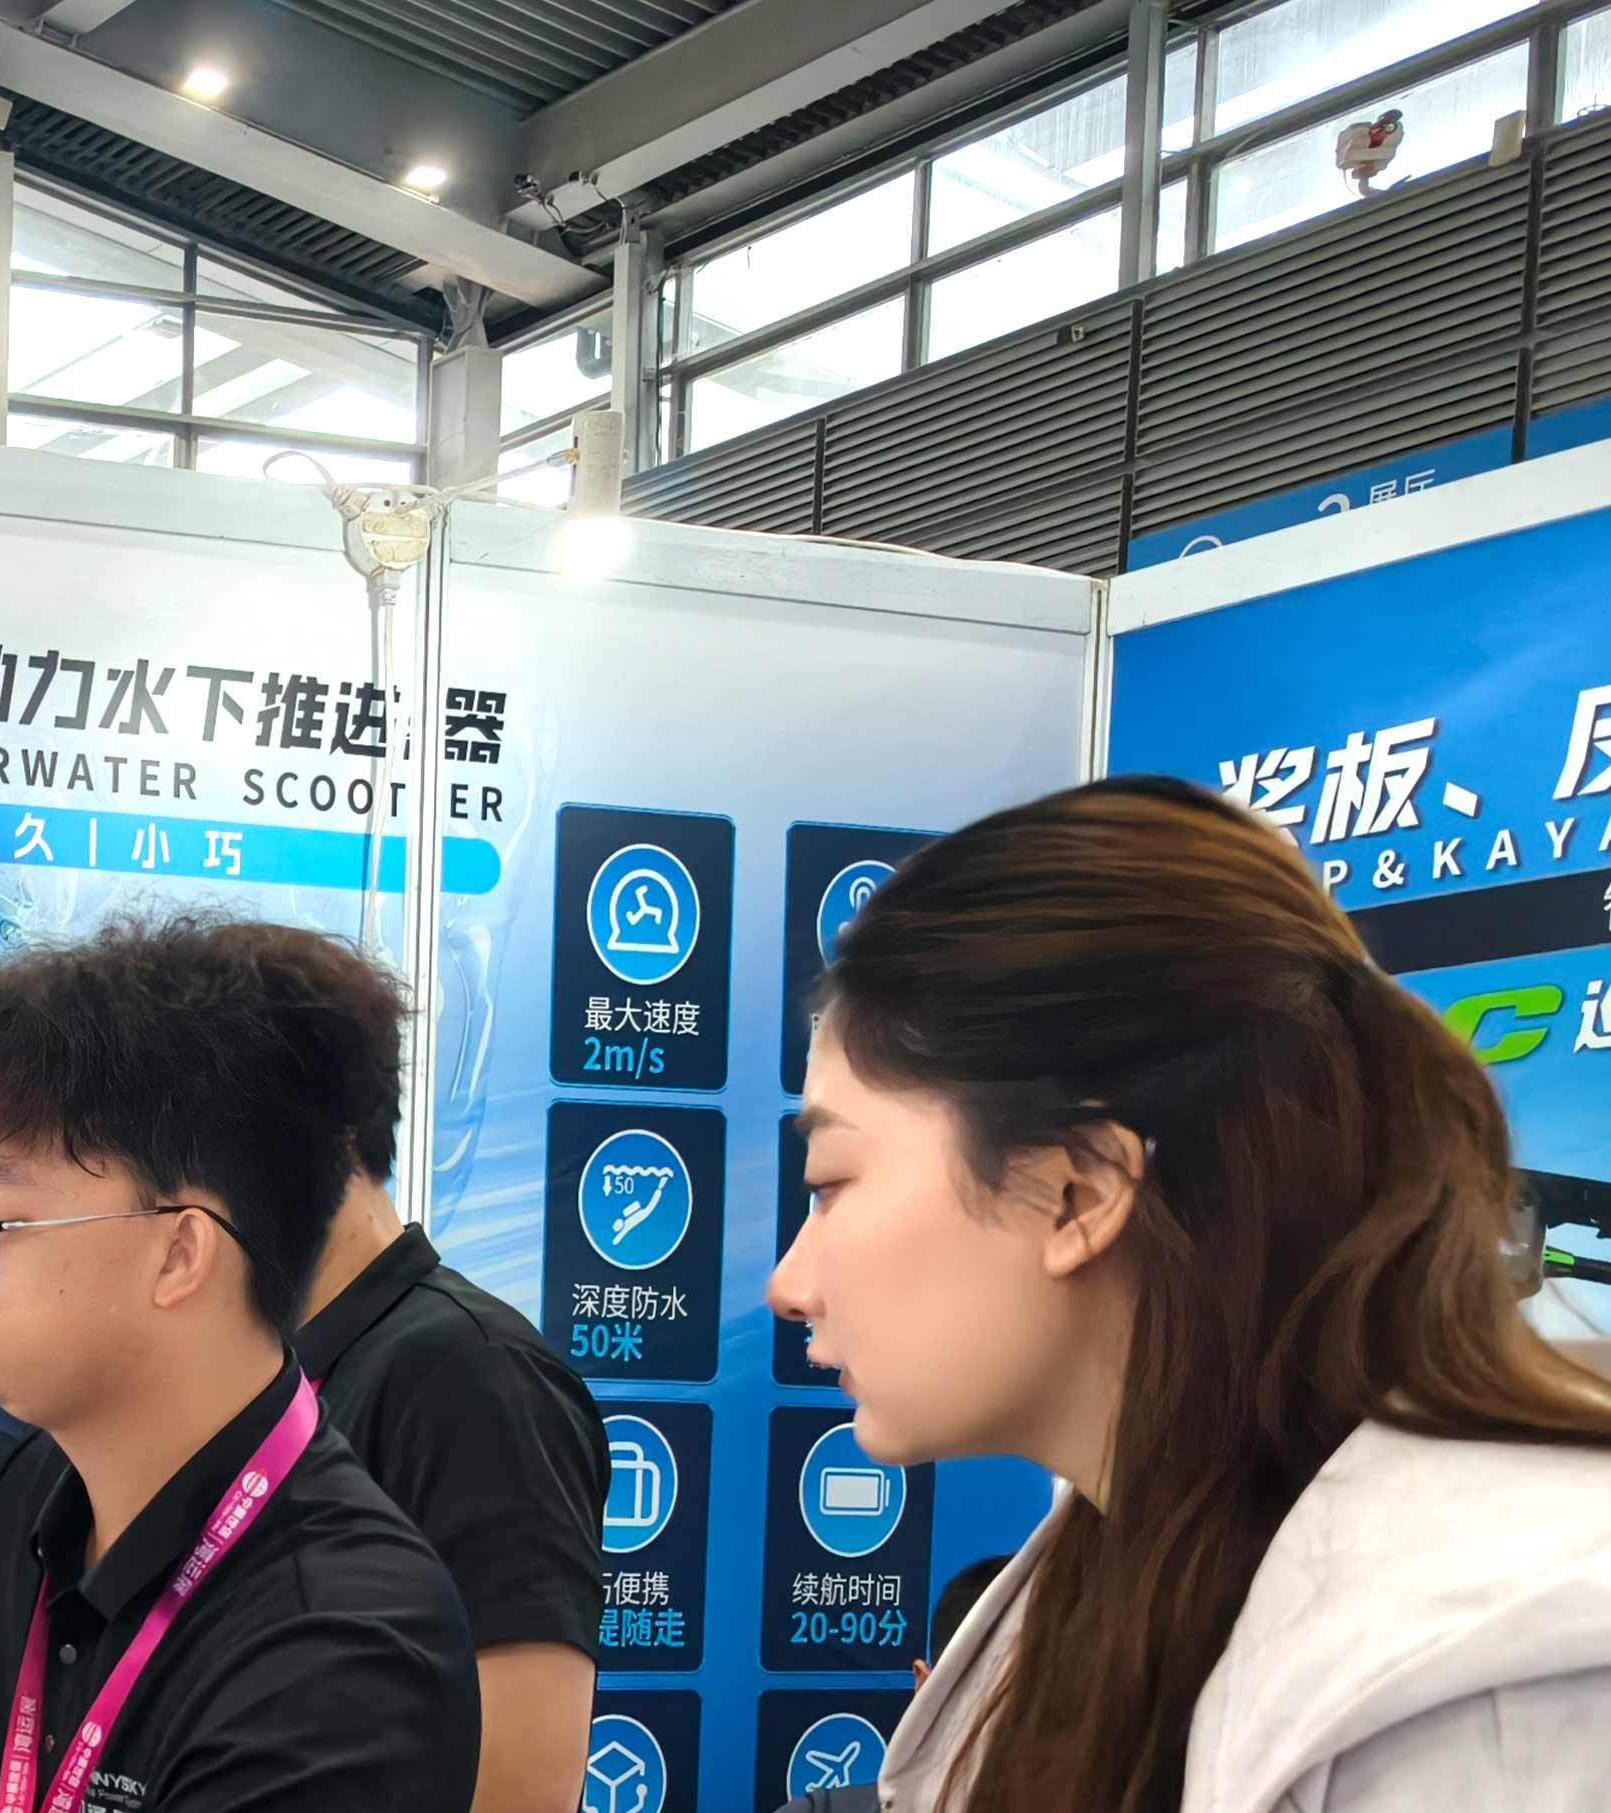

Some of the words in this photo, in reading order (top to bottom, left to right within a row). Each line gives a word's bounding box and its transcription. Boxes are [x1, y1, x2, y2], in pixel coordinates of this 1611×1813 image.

[242, 768, 505, 823] SCOOTER
[130, 821, 244, 876] 小巧
[584, 996, 701, 1037] 最大速度
[582, 1036, 666, 1081] 2m/s
[571, 1284, 689, 1321] 深度防水
[570, 1323, 644, 1363] 50米
[791, 1572, 903, 1607] 续航时间
[789, 1607, 908, 1648] 20-90分
